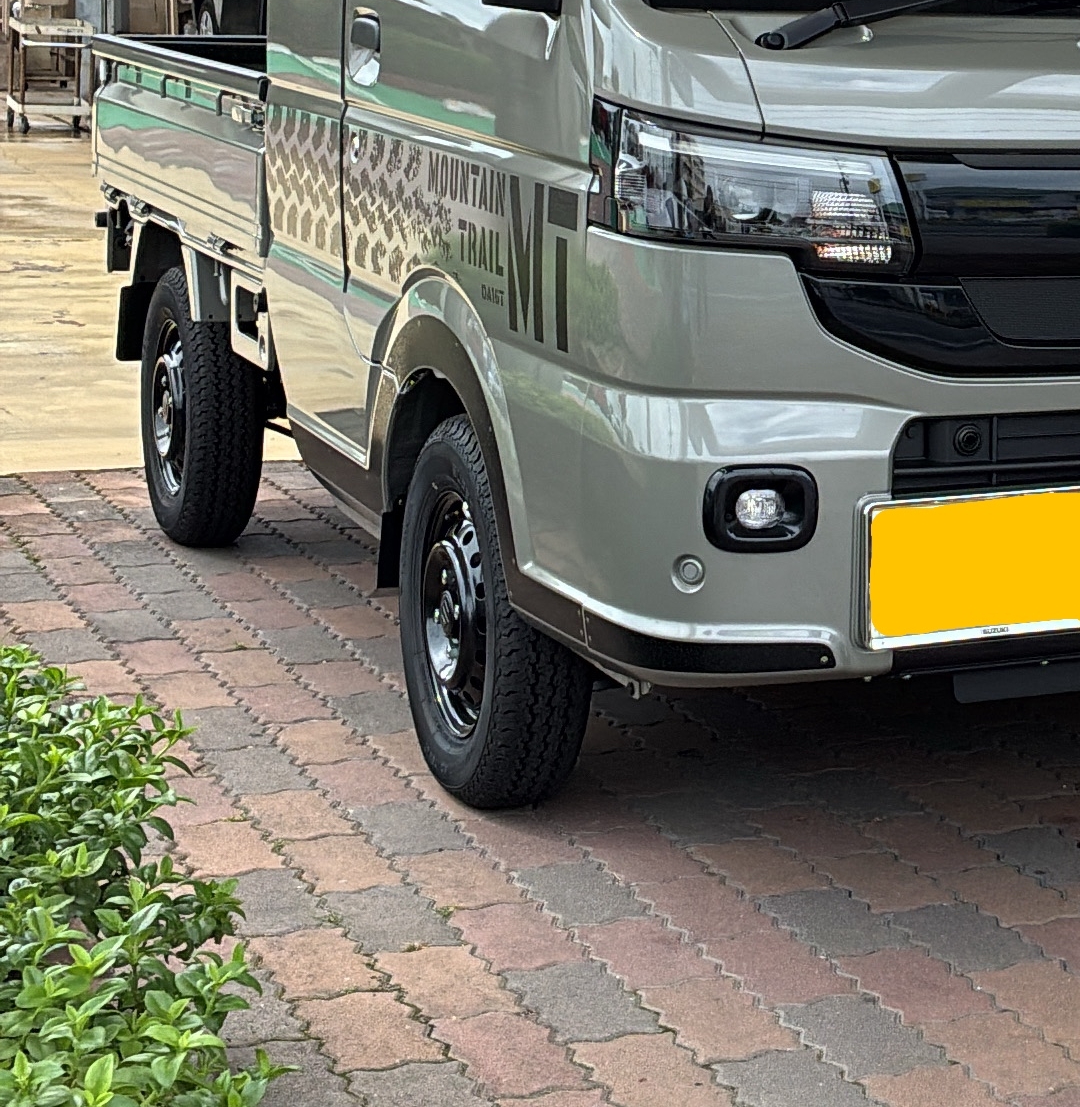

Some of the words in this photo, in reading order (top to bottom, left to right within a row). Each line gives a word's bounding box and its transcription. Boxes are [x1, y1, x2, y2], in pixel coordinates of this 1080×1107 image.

[427, 150, 506, 218] MOUNTAIN
[458, 218, 504, 277] TRAIL
[507, 174, 579, 354] MT
